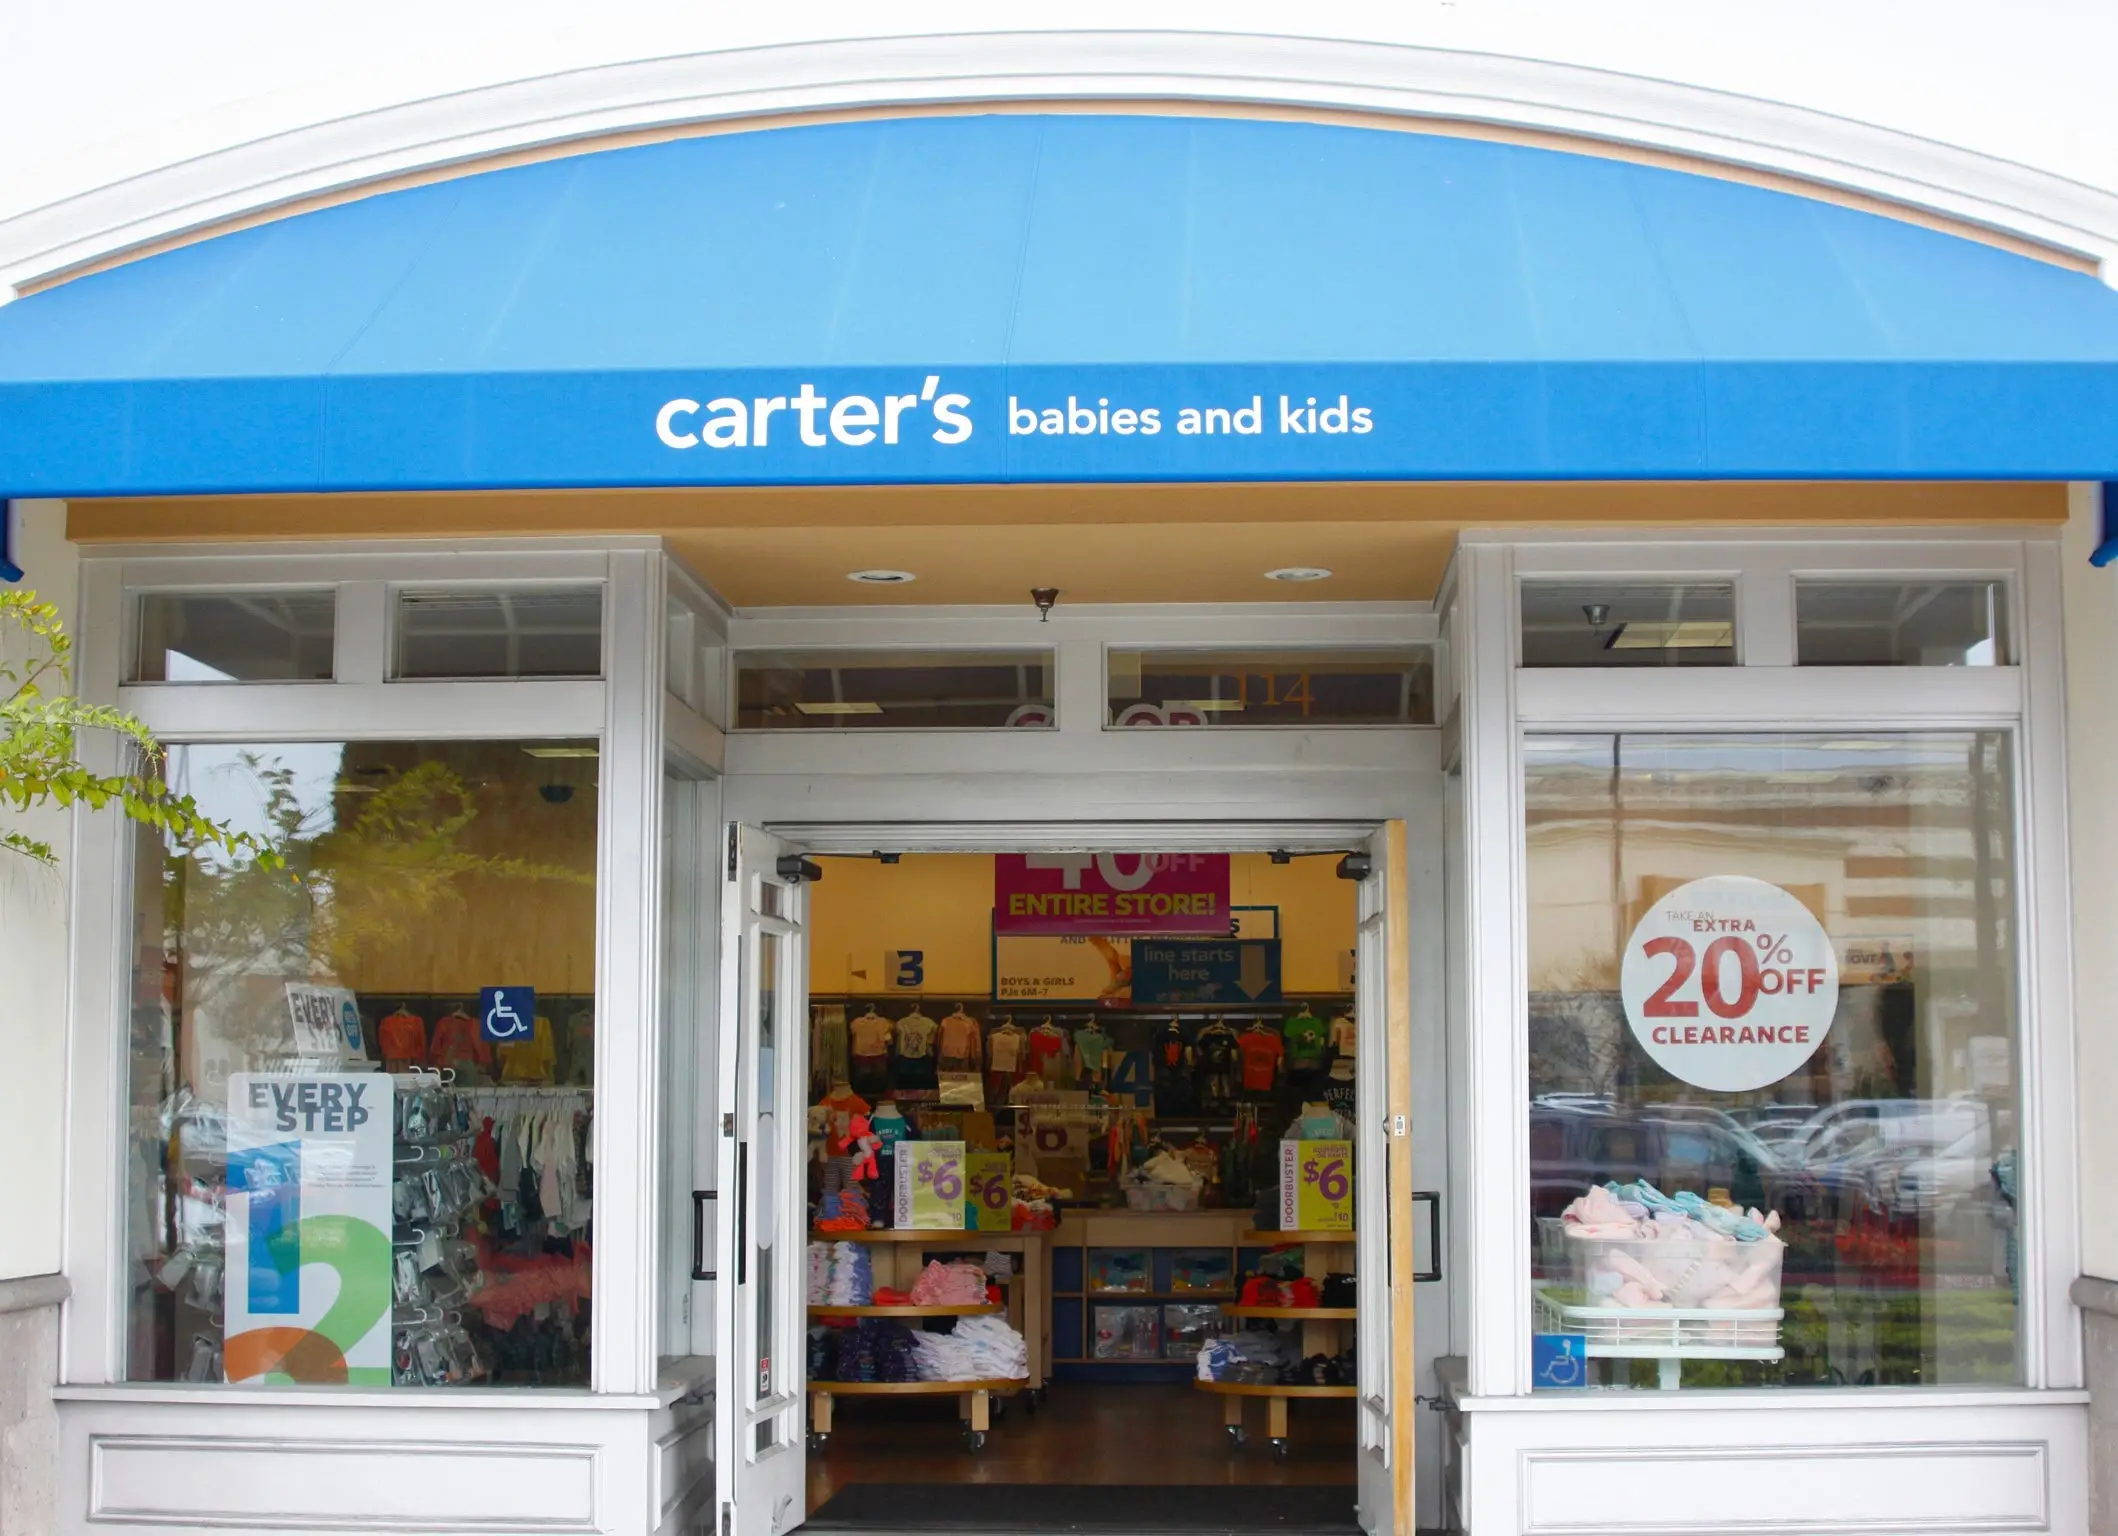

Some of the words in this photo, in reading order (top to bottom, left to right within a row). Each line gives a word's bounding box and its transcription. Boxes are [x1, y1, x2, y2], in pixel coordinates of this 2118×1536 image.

[655, 374, 973, 449] carter's
[1008, 395, 1161, 435] babies
[1177, 396, 1263, 435] and
[1279, 394, 1374, 434] kids
[1008, 893, 1109, 916] ENTIRE
[1114, 892, 1217, 916] STORE!
[1664, 910, 1693, 922] TAKE
[1697, 911, 1714, 922] AN
[1692, 919, 1757, 933] EXTRA
[1143, 945, 1175, 962] line
[1180, 947, 1234, 962] starts
[897, 950, 924, 987] 3
[1000, 977, 1030, 987] BOYS
[1043, 977, 1075, 987] GIRLS
[1168, 964, 1210, 982] here
[1758, 968, 1827, 995] OFF
[1651, 1025, 1810, 1045] CLEARANCE
[1110, 1051, 1153, 1107] 4
[248, 1082, 368, 1113] EVERY
[276, 1105, 369, 1132] STEP
[917, 1159, 963, 1201] $6
[969, 1172, 1009, 1210] $6
[1284, 1148, 1295, 1223] DOORBUSTER
[1303, 1157, 1349, 1201] $6
